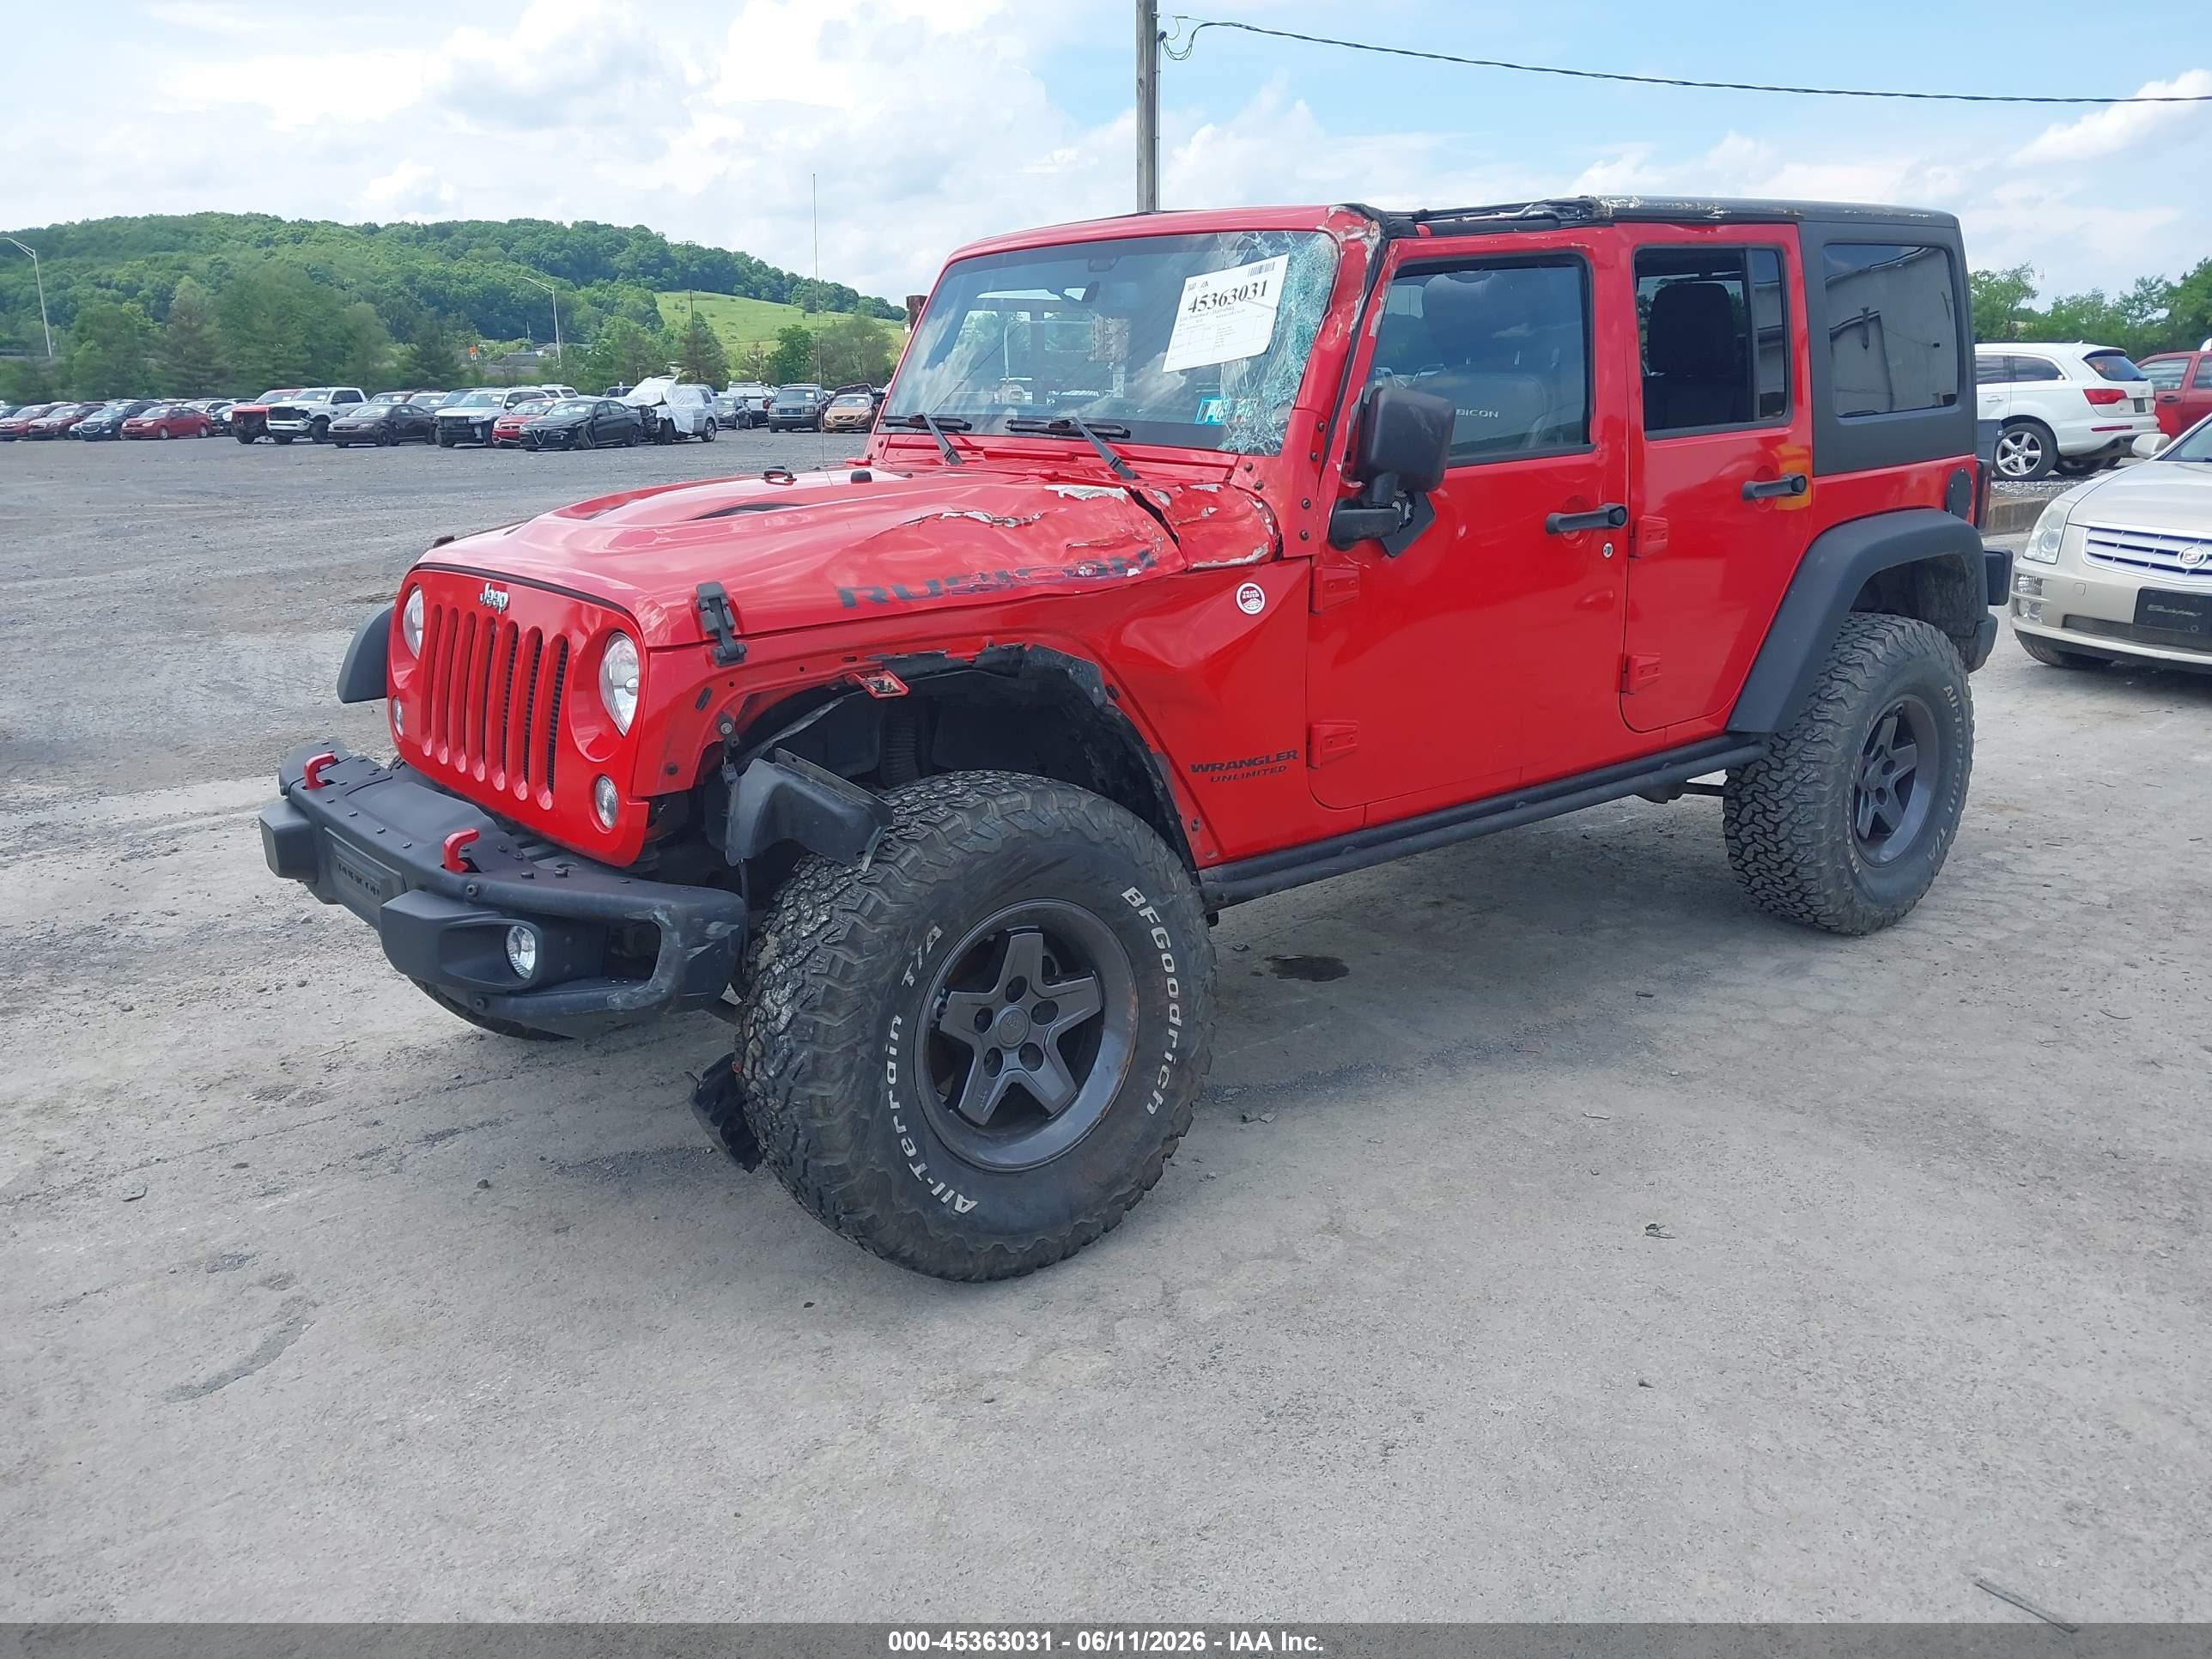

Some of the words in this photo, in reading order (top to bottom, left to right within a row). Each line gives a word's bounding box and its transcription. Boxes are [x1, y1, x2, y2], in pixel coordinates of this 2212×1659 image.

[1188, 280, 1268, 313] 45363031
[1455, 409, 1499, 419] BICON
[479, 582, 509, 616] Jeep
[1189, 750, 1298, 774] WRANGLER
[1209, 765, 1287, 783] UNLIMITED
[1121, 886, 1183, 1115] BFGoodrich
[884, 1014, 979, 1214] All-Terrain
